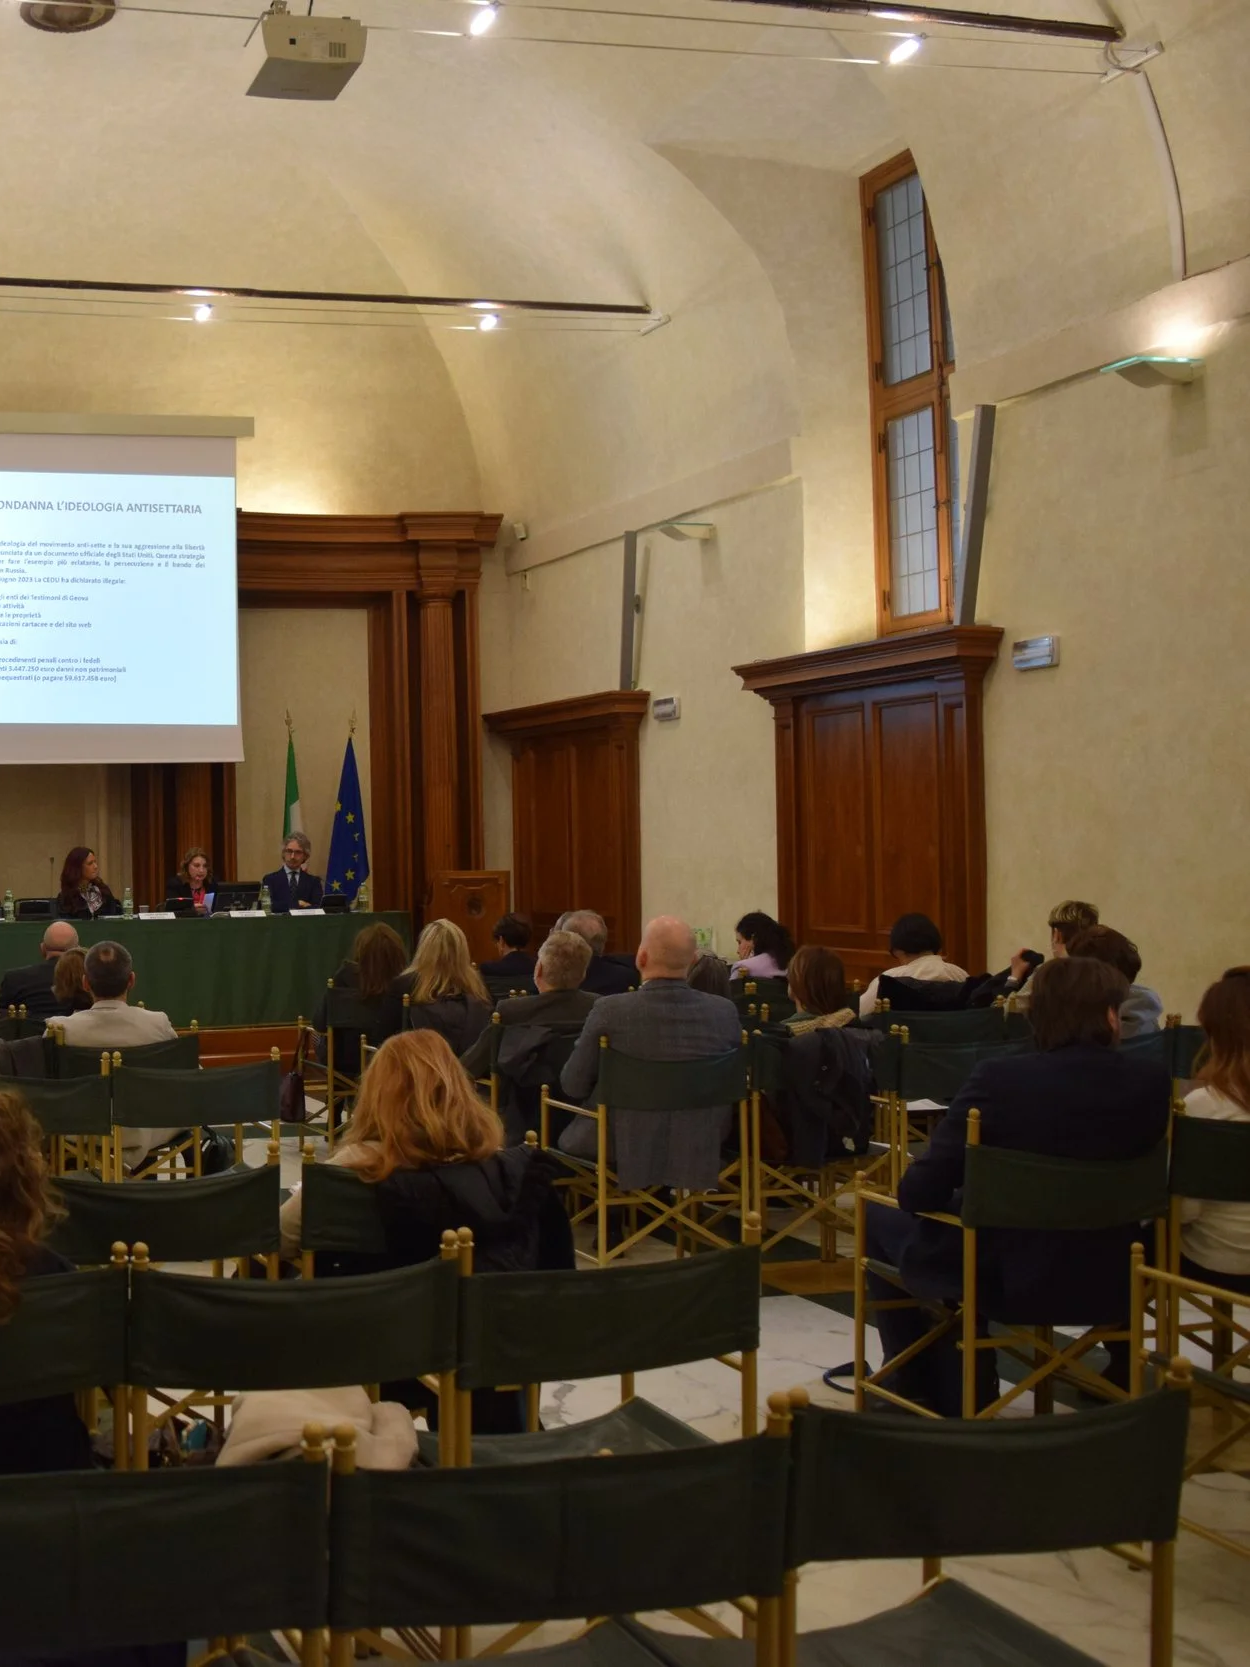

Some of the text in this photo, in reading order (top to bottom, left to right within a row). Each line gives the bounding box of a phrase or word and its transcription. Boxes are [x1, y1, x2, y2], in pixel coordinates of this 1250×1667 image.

[57, 501, 123, 512] L'IDEOLOGIA
[127, 503, 202, 514] ANTISETTARIA
[134, 543, 170, 552] aggressione
[172, 543, 182, 551] alla
[185, 543, 205, 551] libertà
[106, 551, 120, 559] degli
[179, 553, 204, 561] strategia
[58, 559, 67, 567] più
[114, 560, 154, 568] persecuzione
[173, 561, 191, 569] bando
[195, 561, 205, 569] dei
[43, 576, 59, 584] CEDU
[71, 576, 101, 584] dichiarato
[70, 594, 88, 602] Geova
[12, 611, 41, 620] proprietà
[55, 620, 64, 629] del
[78, 621, 91, 629] web
[38, 656, 56, 665] penali
[83, 656, 100, 664] fedeli
[42, 675, 63, 683] pagare
